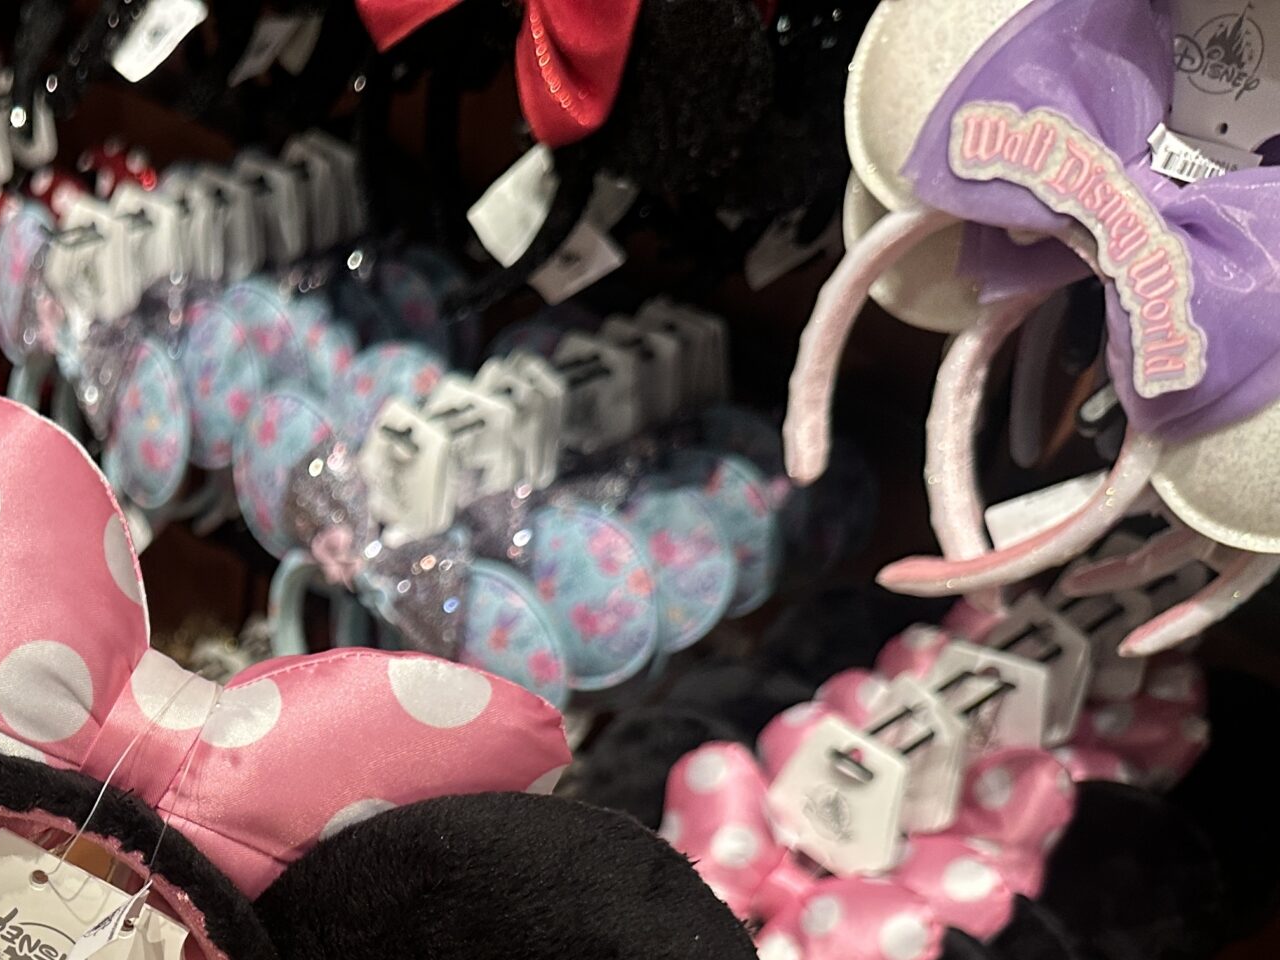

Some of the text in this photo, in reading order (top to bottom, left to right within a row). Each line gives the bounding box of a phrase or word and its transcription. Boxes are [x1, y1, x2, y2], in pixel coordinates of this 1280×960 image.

[961, 116, 1188, 379] Walt Disney World
